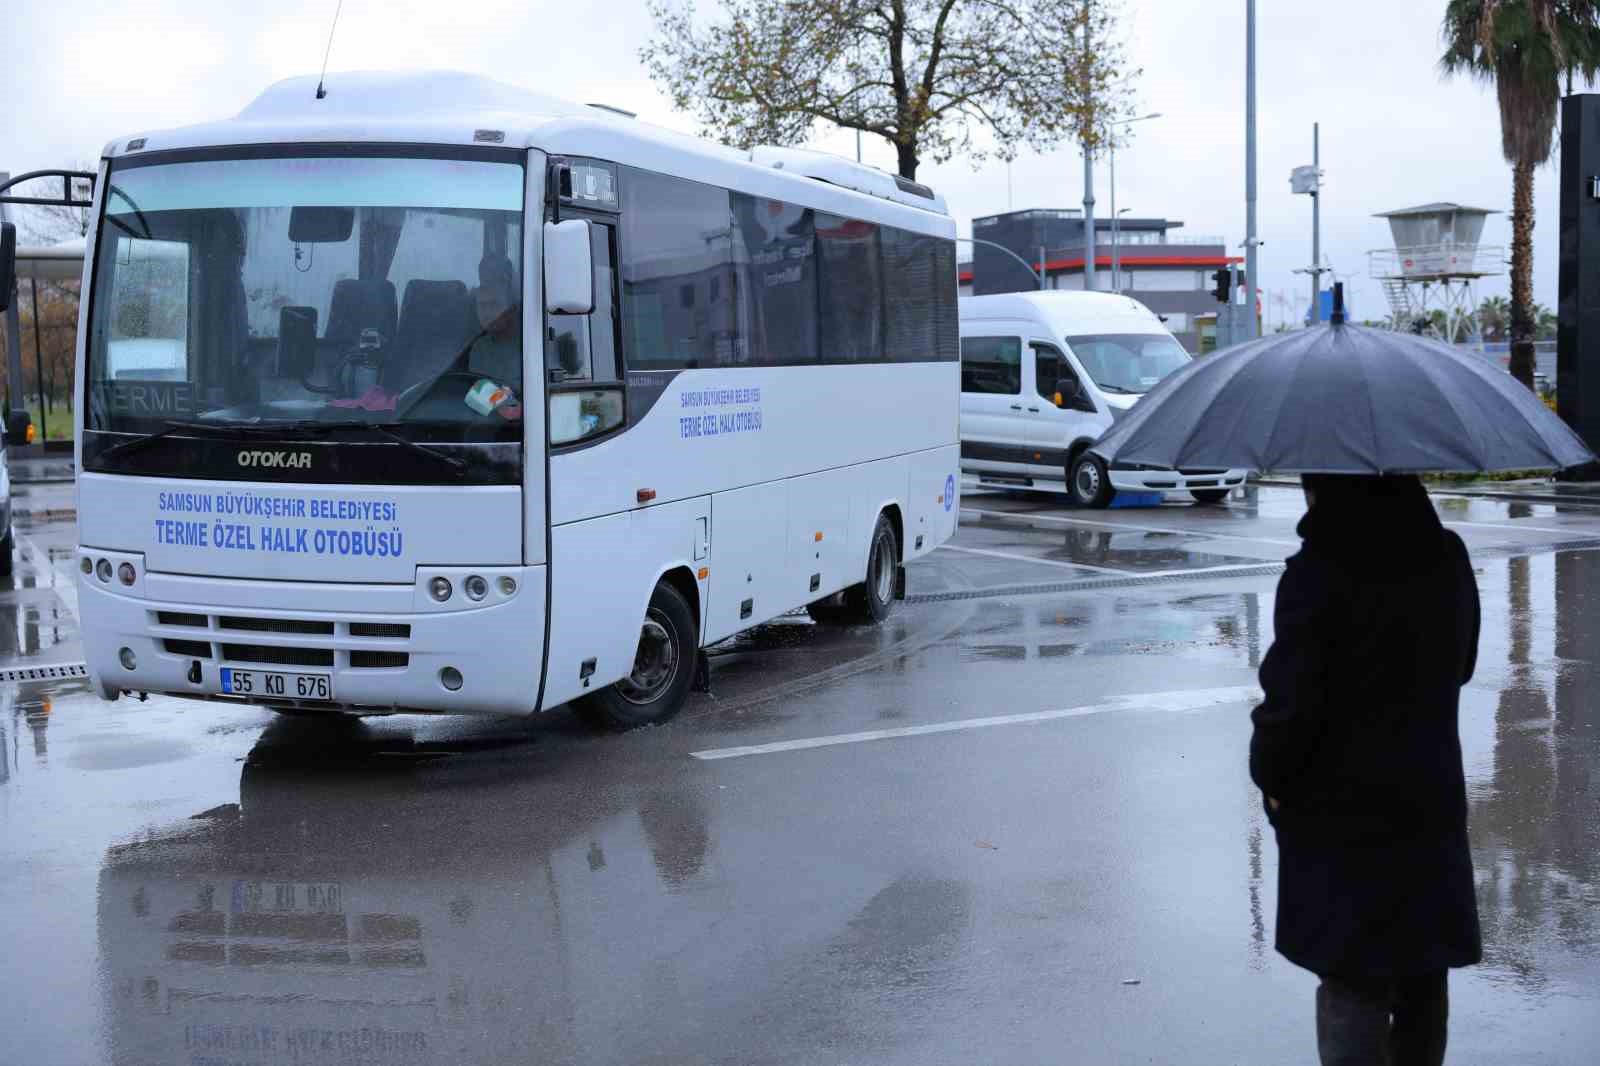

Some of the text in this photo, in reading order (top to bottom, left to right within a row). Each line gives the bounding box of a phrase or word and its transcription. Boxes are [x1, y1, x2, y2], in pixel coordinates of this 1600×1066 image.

[680, 416, 702, 438] TERME
[719, 413, 736, 433] HALK
[237, 450, 312, 468] OTOKAR
[159, 492, 212, 513] SAMSUN
[155, 518, 402, 557] TERME ÖZEL HALK OTOBÜSÜ
[233, 672, 327, 697] 55 KD 676
